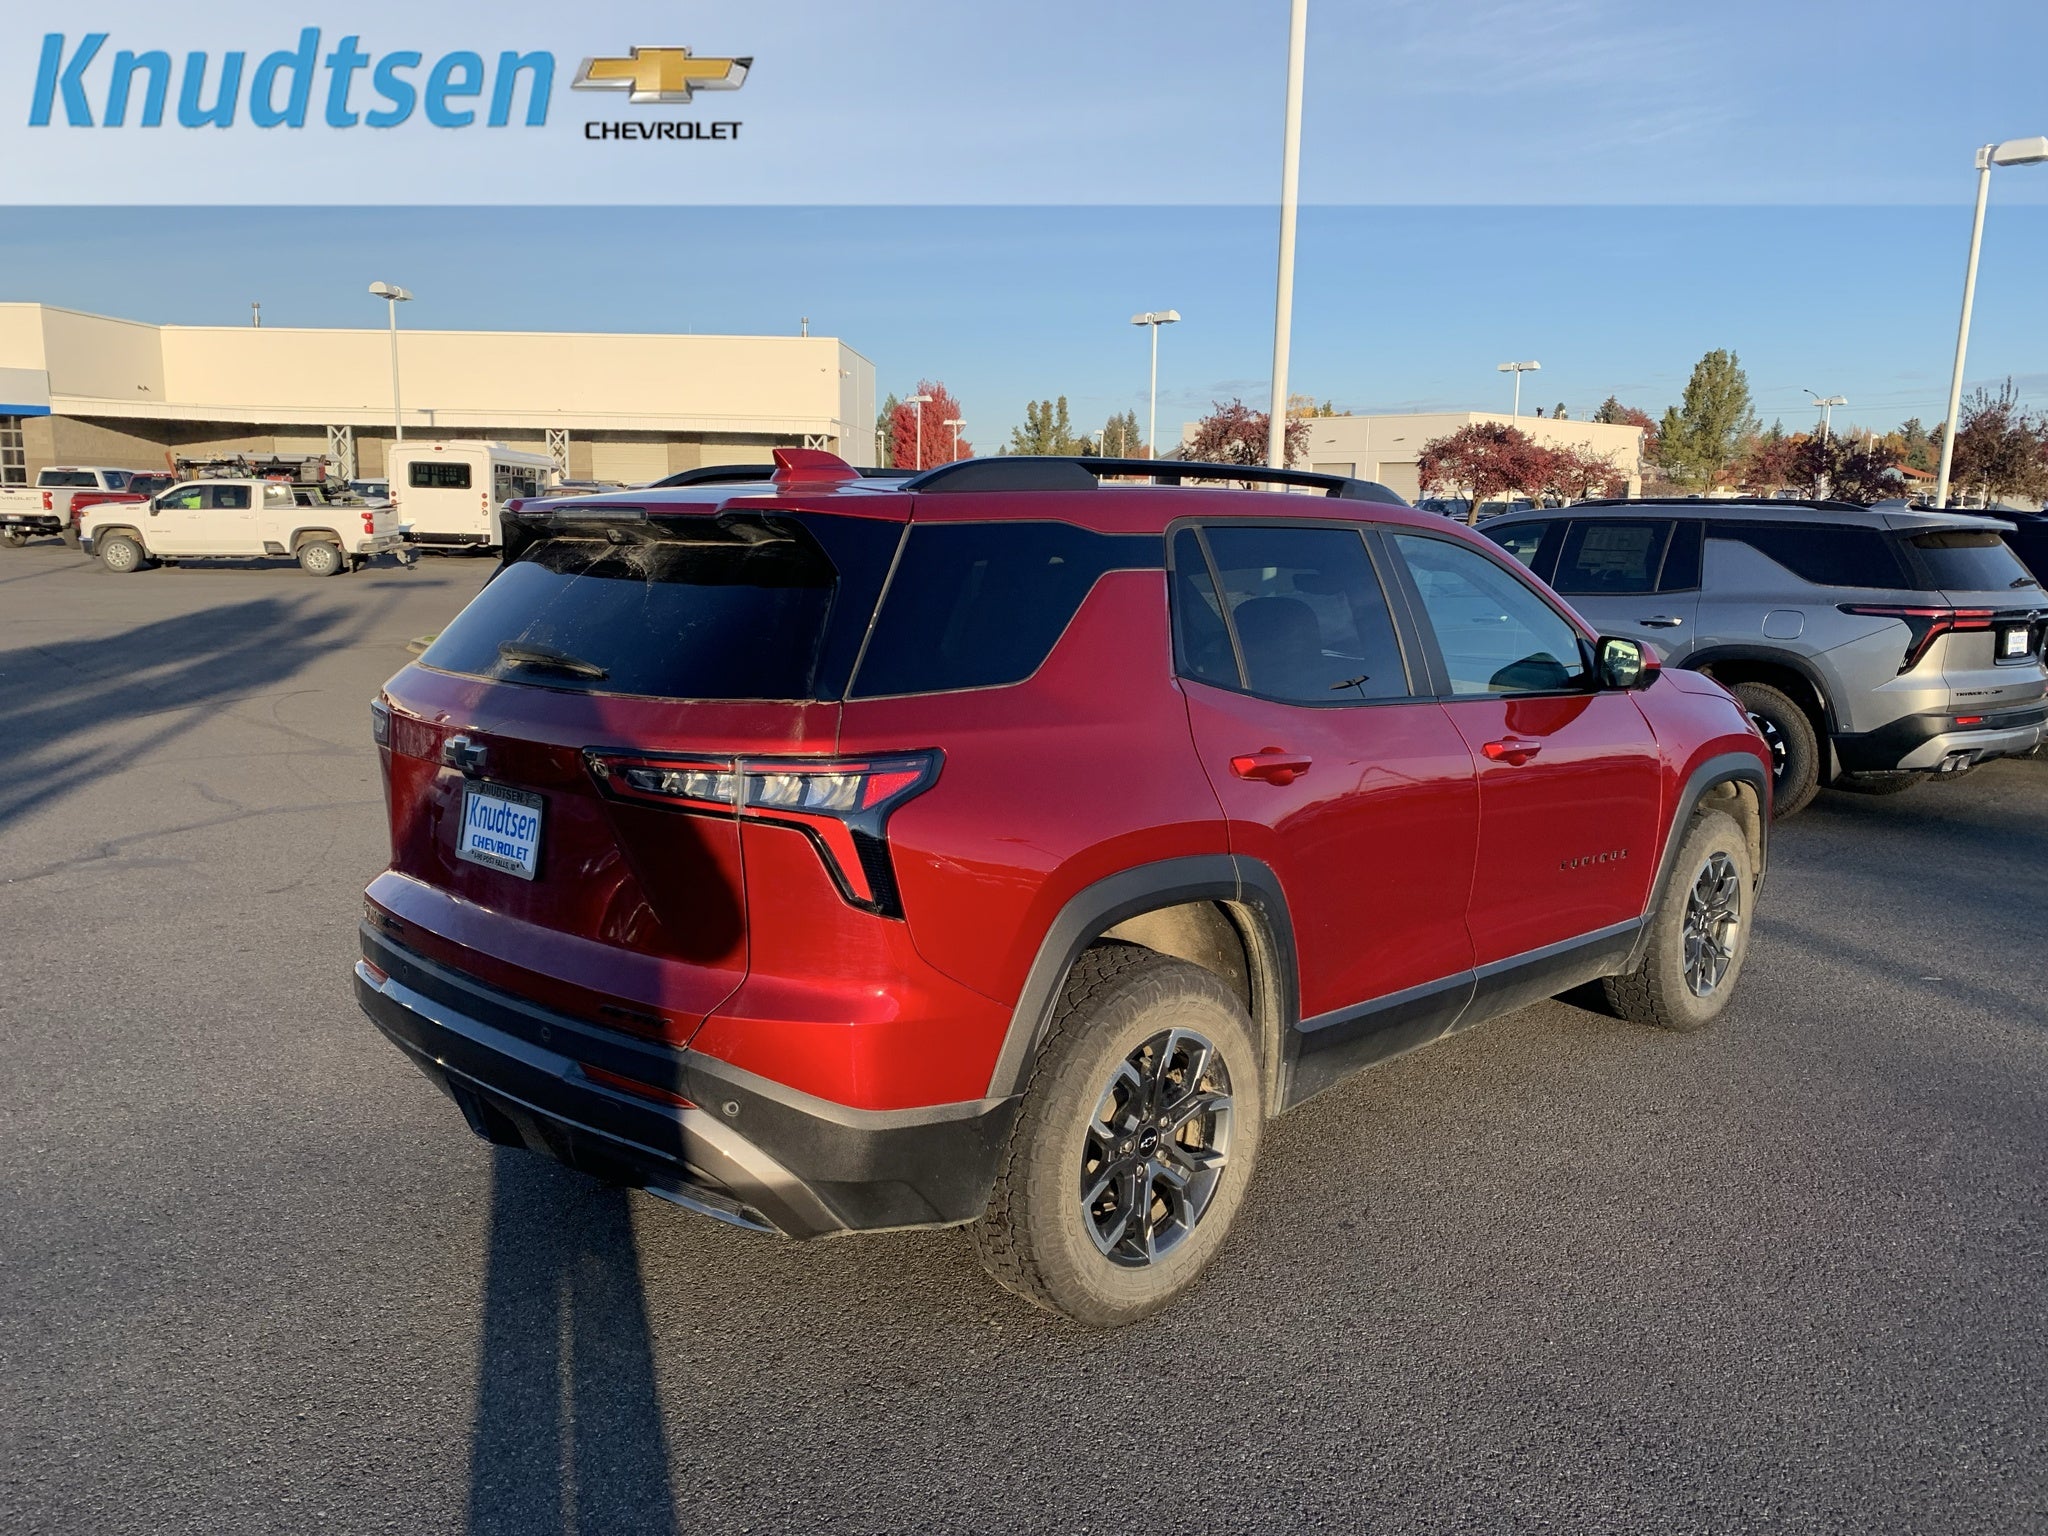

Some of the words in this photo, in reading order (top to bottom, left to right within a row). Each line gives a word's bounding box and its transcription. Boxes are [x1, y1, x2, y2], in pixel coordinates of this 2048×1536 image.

[481, 782, 524, 803] KNUDTSEN
[468, 796, 536, 842] Knudtsen
[472, 834, 529, 861] CHEVROLET
